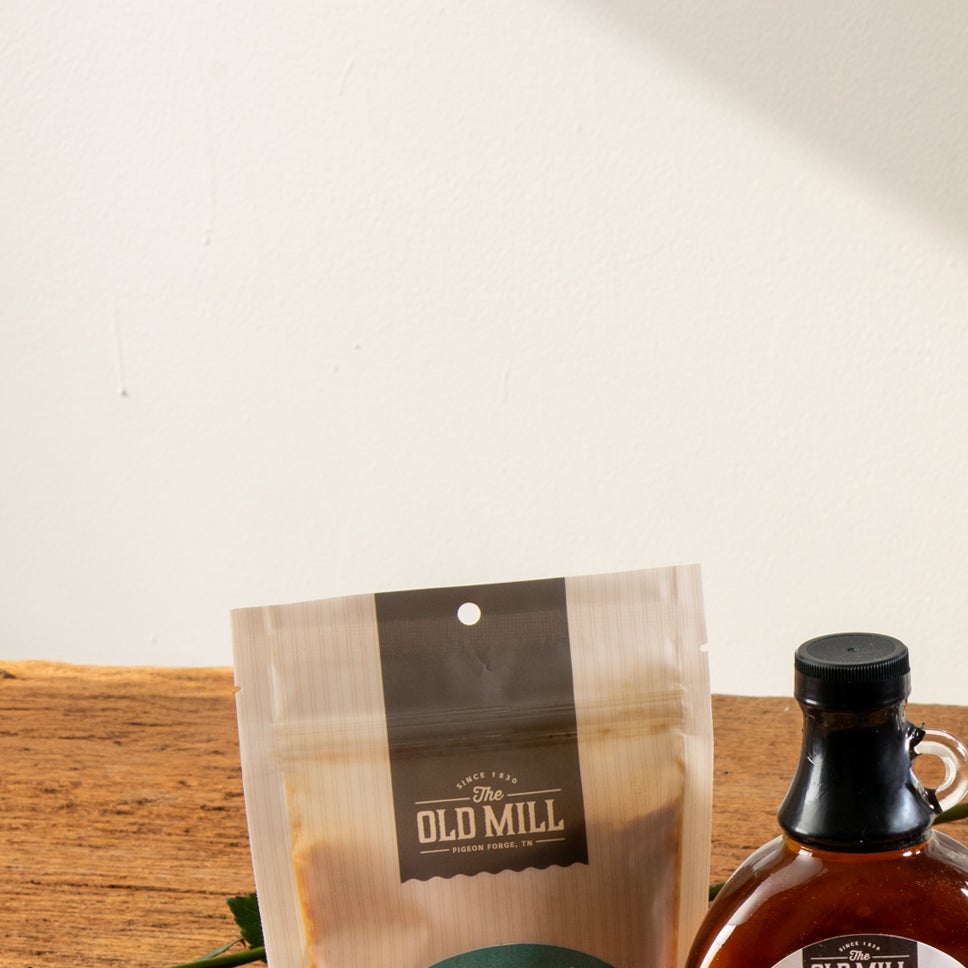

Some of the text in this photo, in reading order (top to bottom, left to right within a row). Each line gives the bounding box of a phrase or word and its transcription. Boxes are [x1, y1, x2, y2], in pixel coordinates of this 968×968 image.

[457, 772, 518, 789] SINCE 1830
[473, 786, 504, 803] The
[417, 799, 564, 844] OLD MILL
[453, 844, 484, 853] PIGEON
[487, 841, 517, 850] FORGE,
[839, 941, 859, 952] SINCE
[849, 950, 870, 961] The
